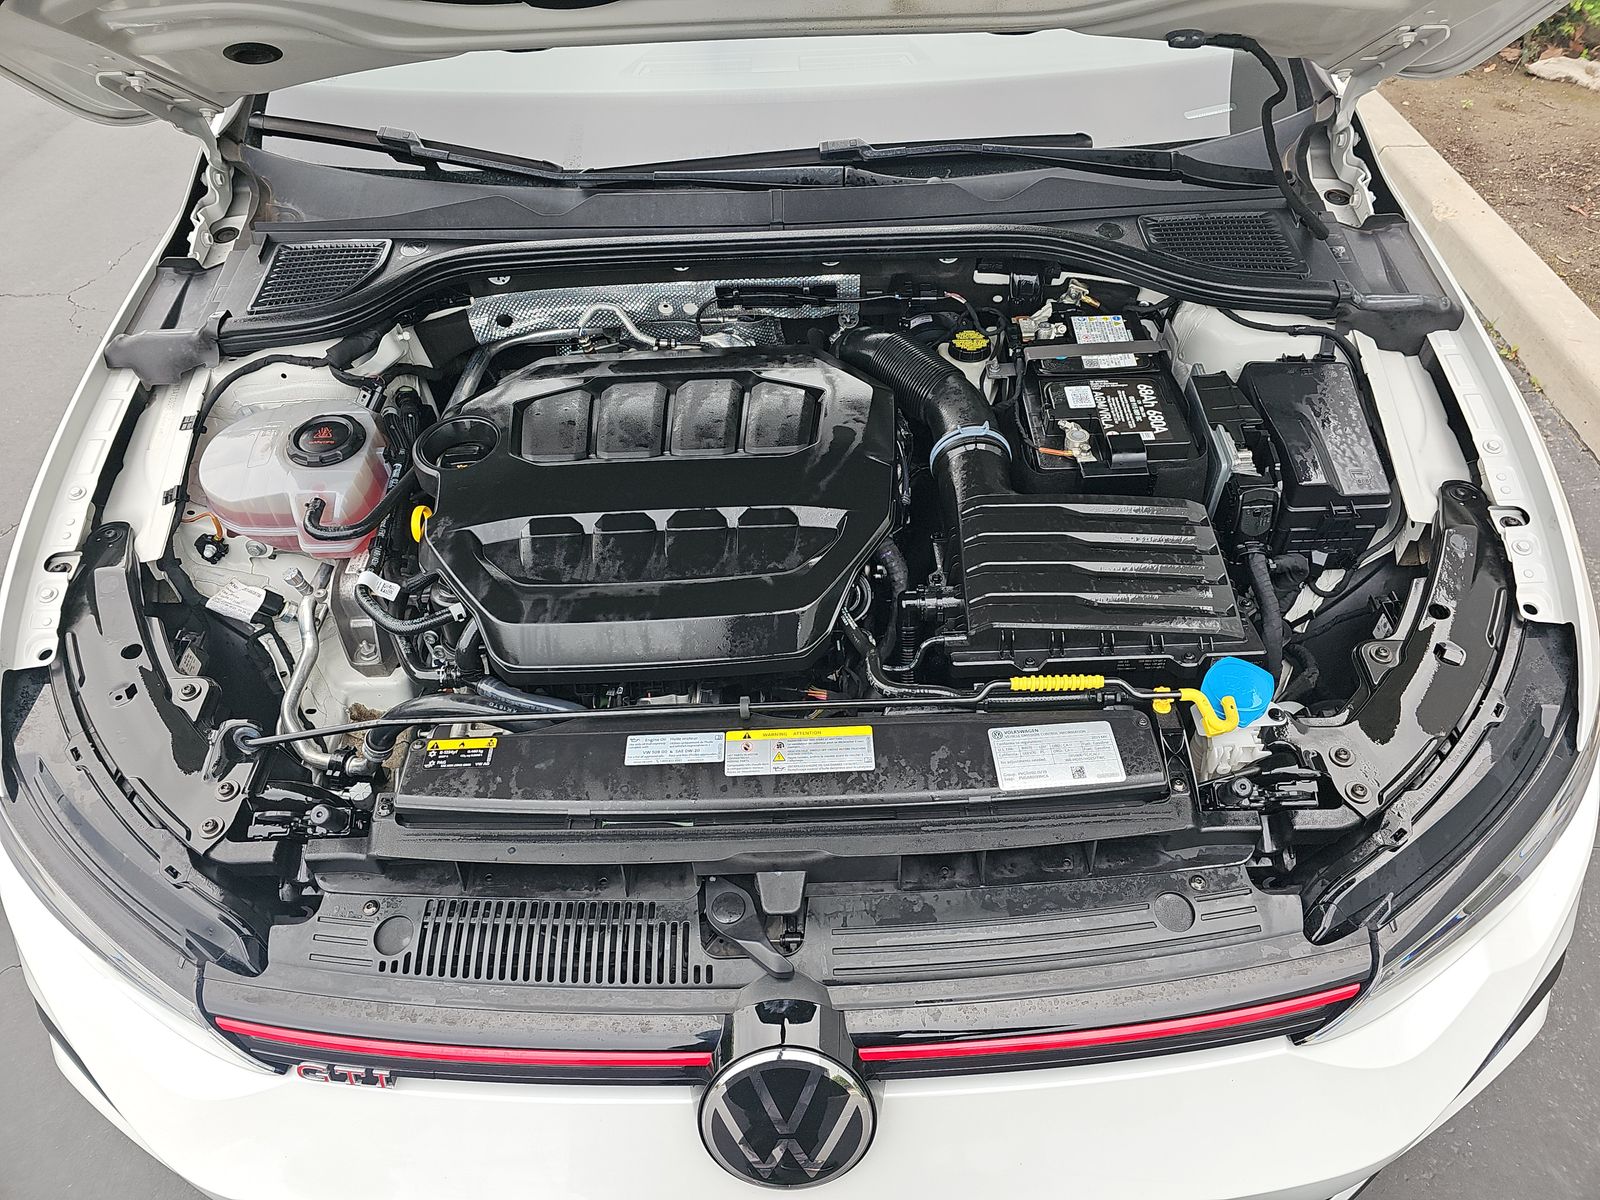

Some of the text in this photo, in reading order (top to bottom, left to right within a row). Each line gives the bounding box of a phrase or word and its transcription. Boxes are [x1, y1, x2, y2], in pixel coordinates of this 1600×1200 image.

[1136, 383, 1158, 408] 68Ah
[1092, 390, 1114, 430] AGM/VRLA
[1146, 409, 1168, 434] 680A
[297, 1061, 396, 1088] GTI
